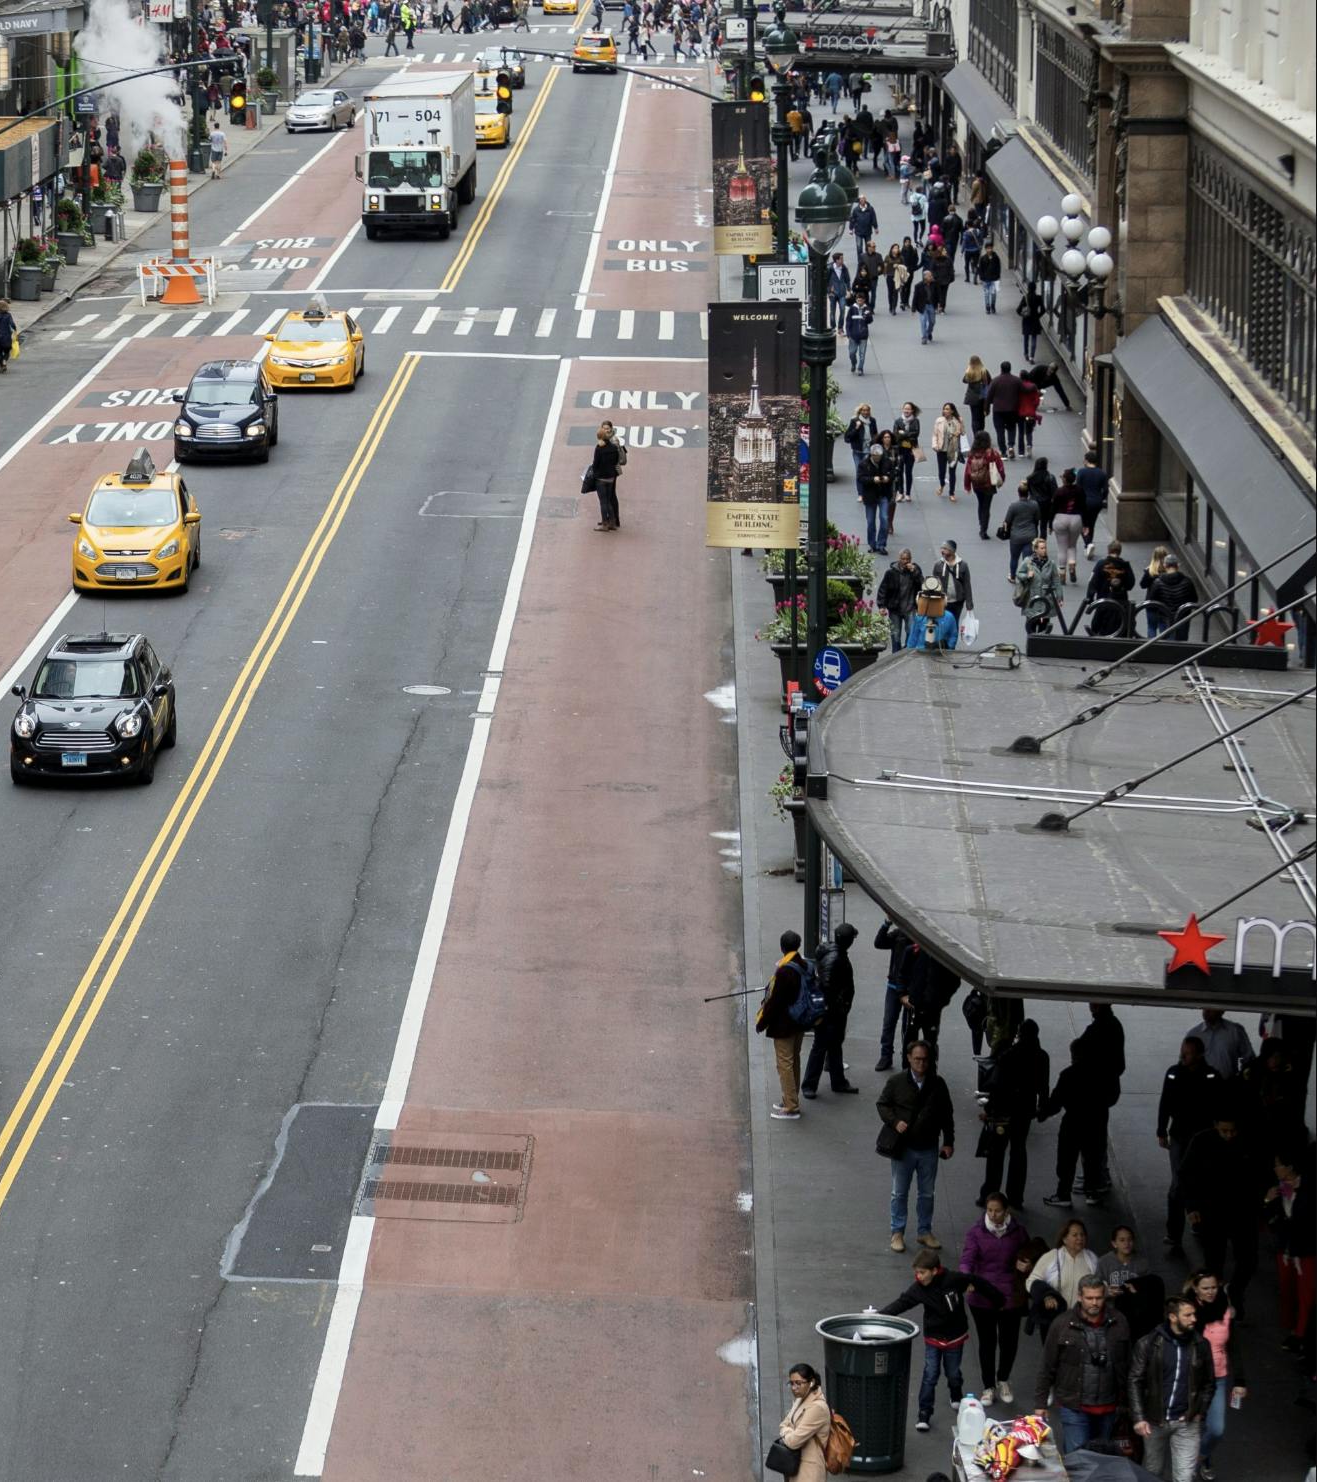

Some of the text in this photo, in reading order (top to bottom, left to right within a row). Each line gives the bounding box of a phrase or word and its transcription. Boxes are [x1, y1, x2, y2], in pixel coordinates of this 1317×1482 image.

[13, 17, 39, 29] NAVY
[415, 110, 441, 121] 504
[256, 237, 316, 249] BUS
[617, 239, 700, 253] ONLY
[626, 258, 689, 272] BUS
[101, 387, 189, 408] BUS
[591, 390, 701, 411] ONLY
[49, 421, 175, 445] ONLY
[726, 513, 780, 521] EMPIRE STATE
